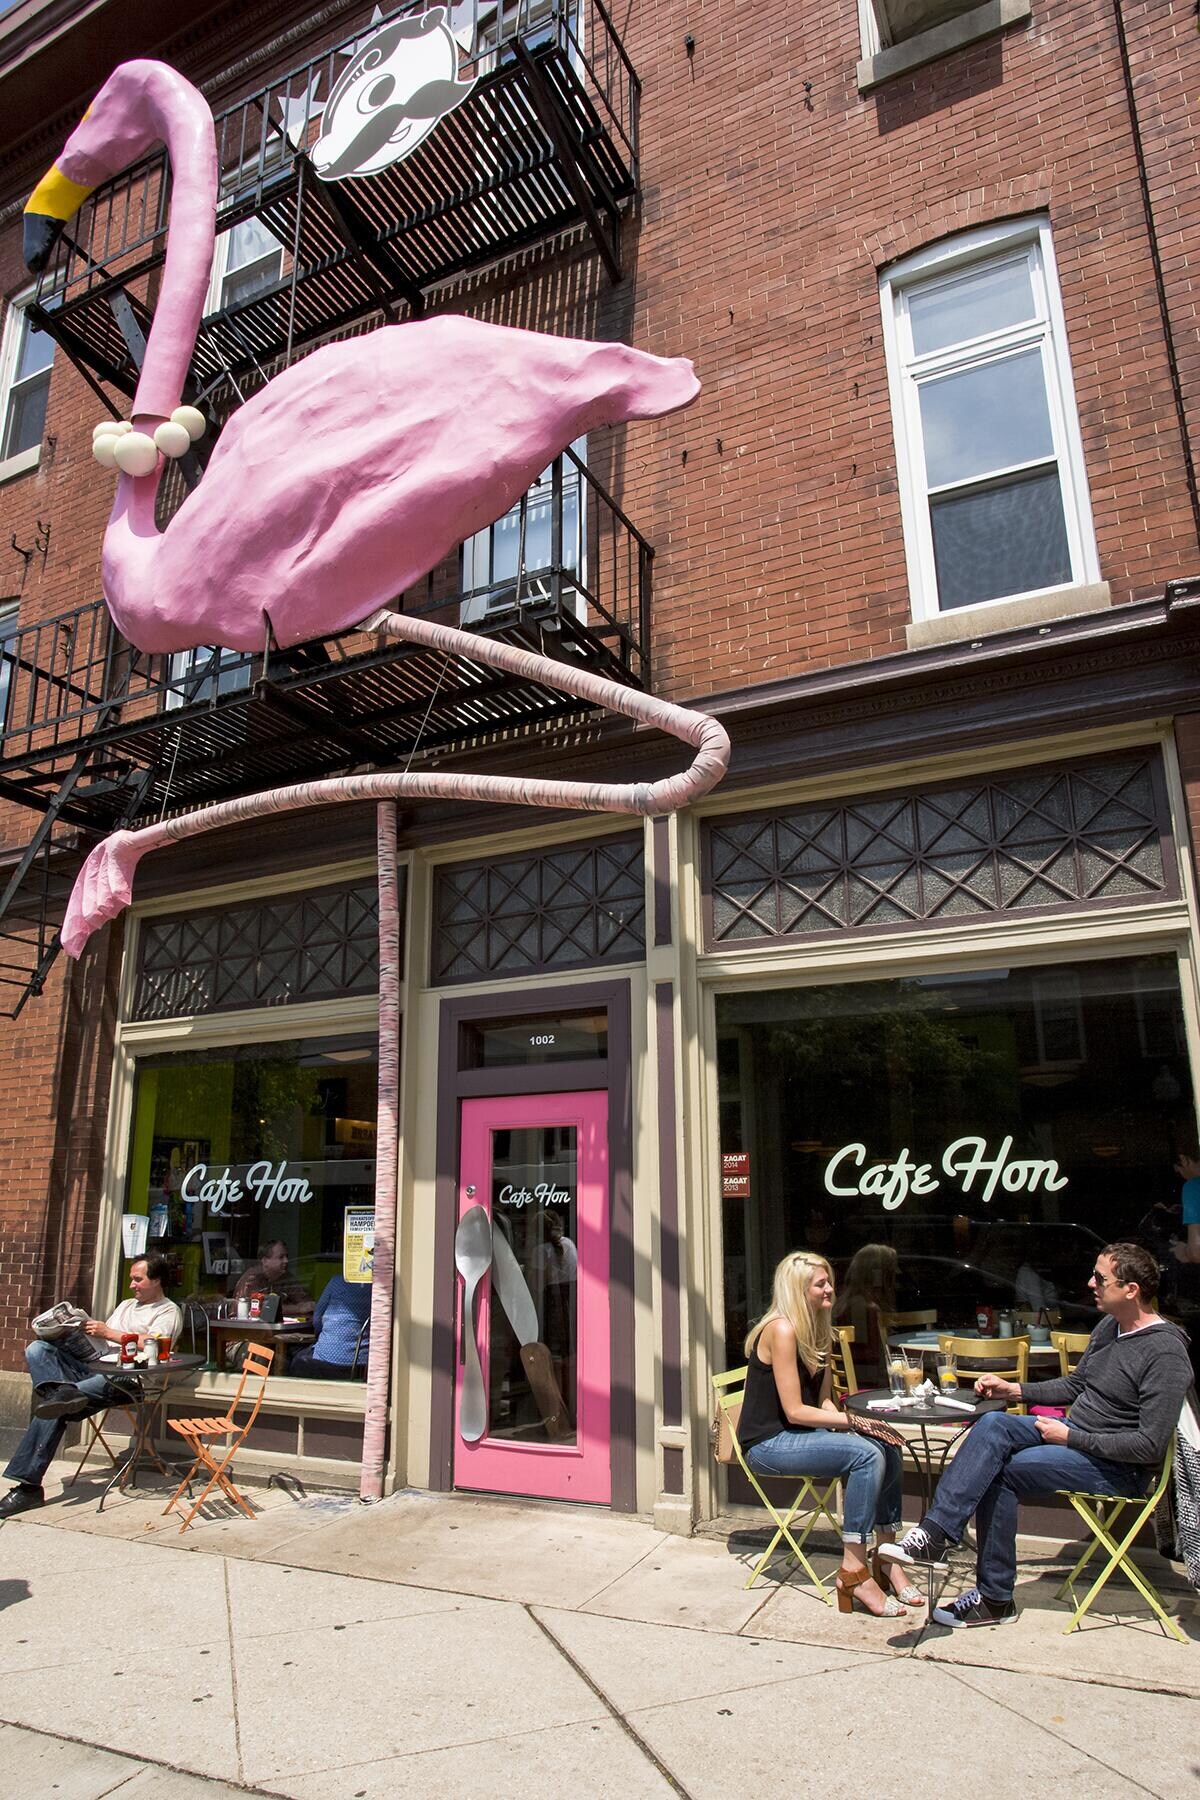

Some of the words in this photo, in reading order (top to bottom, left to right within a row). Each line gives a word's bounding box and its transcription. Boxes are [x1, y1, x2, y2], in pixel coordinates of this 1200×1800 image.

[530, 1034, 555, 1045] 1002
[723, 1154, 747, 1162] ZAGAT
[723, 1161, 738, 1169] 2014
[824, 1142, 940, 1211] Cafe
[942, 1135, 1069, 1203] Hon
[723, 1177, 748, 1185] ZAGAT
[181, 1163, 243, 1213] Cafe
[246, 1160, 313, 1209] Hon
[723, 1184, 739, 1192] 2013
[499, 1184, 534, 1209] Cafe
[534, 1183, 571, 1207] Hon
